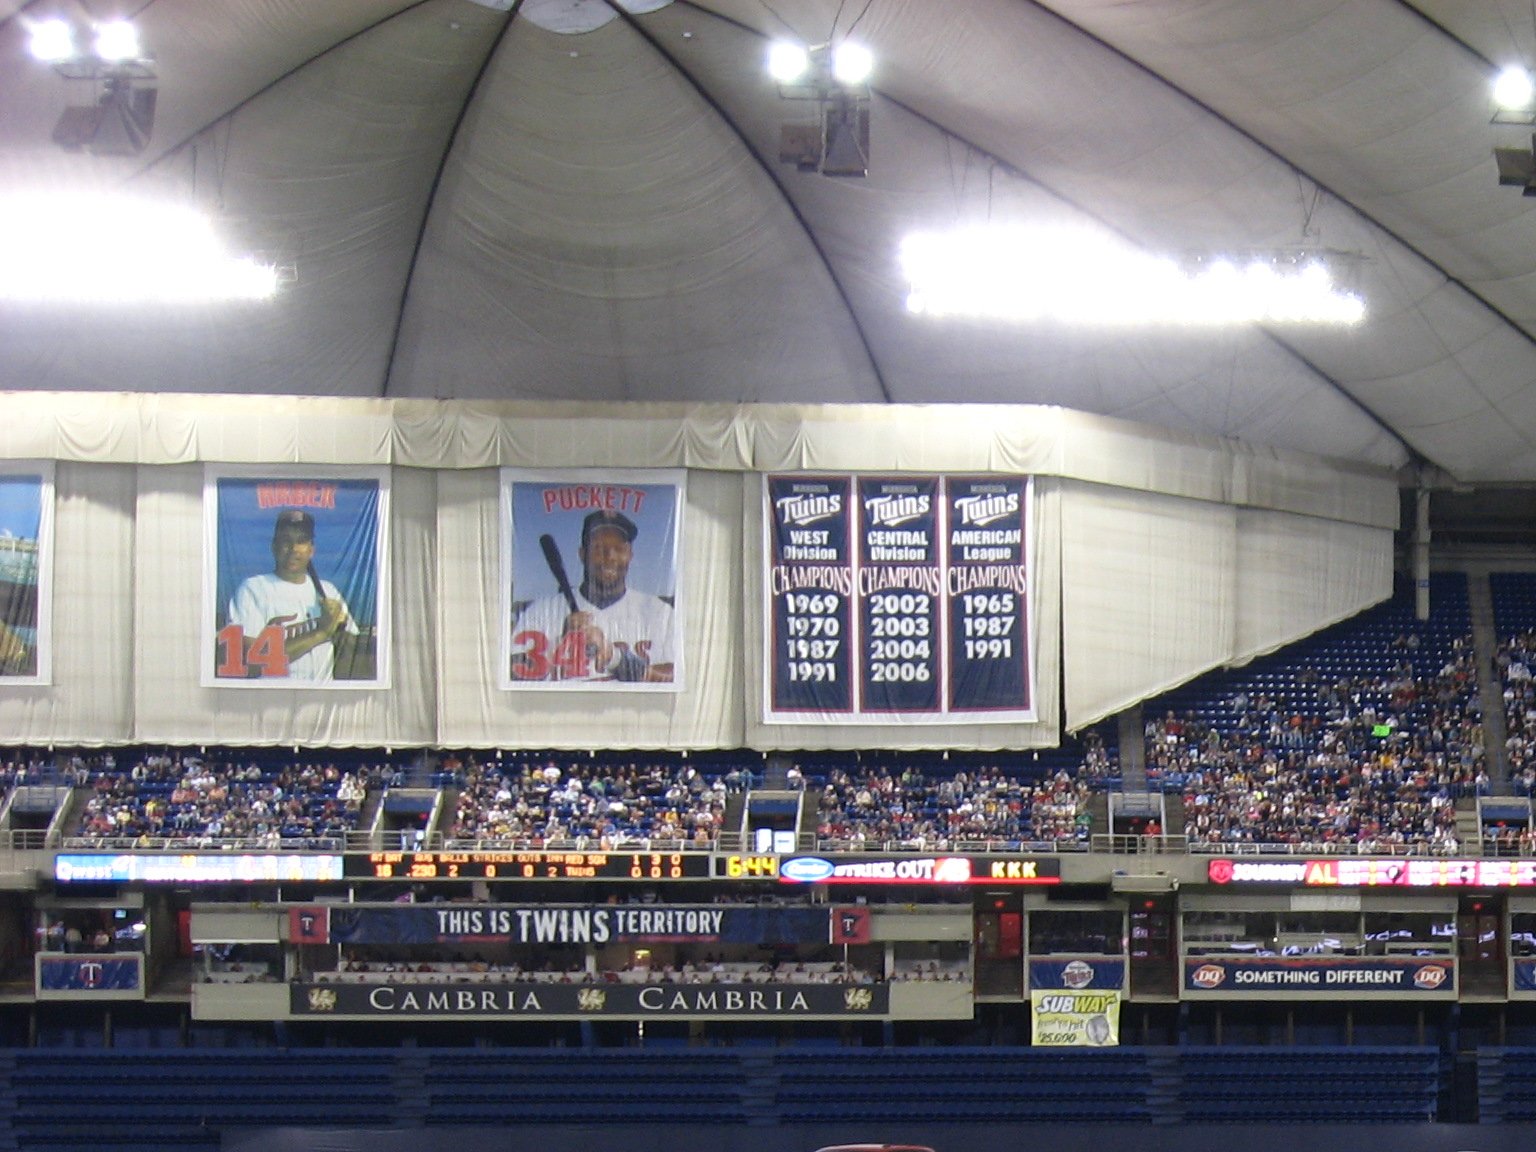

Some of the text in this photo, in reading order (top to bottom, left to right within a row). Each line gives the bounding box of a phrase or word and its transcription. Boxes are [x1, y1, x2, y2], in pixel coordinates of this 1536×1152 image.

[543, 484, 647, 513] PUCKETT
[776, 494, 841, 525] Twins
[865, 494, 930, 525] Twins
[954, 493, 1019, 525] Twins
[790, 530, 829, 545] WEST
[868, 530, 928, 546] CENTRAL
[951, 529, 1022, 545] AMERICAN
[784, 546, 837, 561] Division
[870, 546, 926, 561] Division
[963, 546, 1012, 562] League
[772, 565, 851, 597] CHAMPIONS
[858, 565, 940, 597] CHAMPIONS
[948, 565, 1026, 597] CHAMPIONS
[786, 594, 839, 615] 1969
[870, 594, 930, 615] 2002
[963, 594, 1014, 614] 1965
[787, 617, 839, 637] 1970
[870, 617, 930, 637] 2003
[963, 616, 1015, 637] 1987
[217, 625, 289, 677] 14
[511, 630, 589, 680] 34
[787, 640, 840, 660] 1987
[870, 640, 930, 660] 2004
[964, 639, 1012, 659] 1991
[788, 662, 836, 682] 1991
[870, 662, 930, 682] 2006
[633, 854, 640, 865] 1
[671, 854, 681, 865] 0
[726, 856, 776, 876] 6:44
[897, 859, 934, 879] OUT
[449, 864, 458, 877] 2
[548, 867, 557, 877] 2
[631, 866, 642, 878] 0
[651, 866, 661, 878] 0
[671, 866, 681, 878] 0
[1307, 863, 1338, 884] AL
[438, 910, 724, 943] THIS IS TWINS TERRITORY
[1198, 970, 1221, 982] DQ
[1235, 970, 1404, 983] SOMETHING DIFFERENT
[1419, 970, 1441, 982] DQ
[369, 986, 541, 1010] CAMBRIA
[637, 986, 809, 1010] CAMBRIA
[1036, 993, 1116, 1014] SUBWAY
